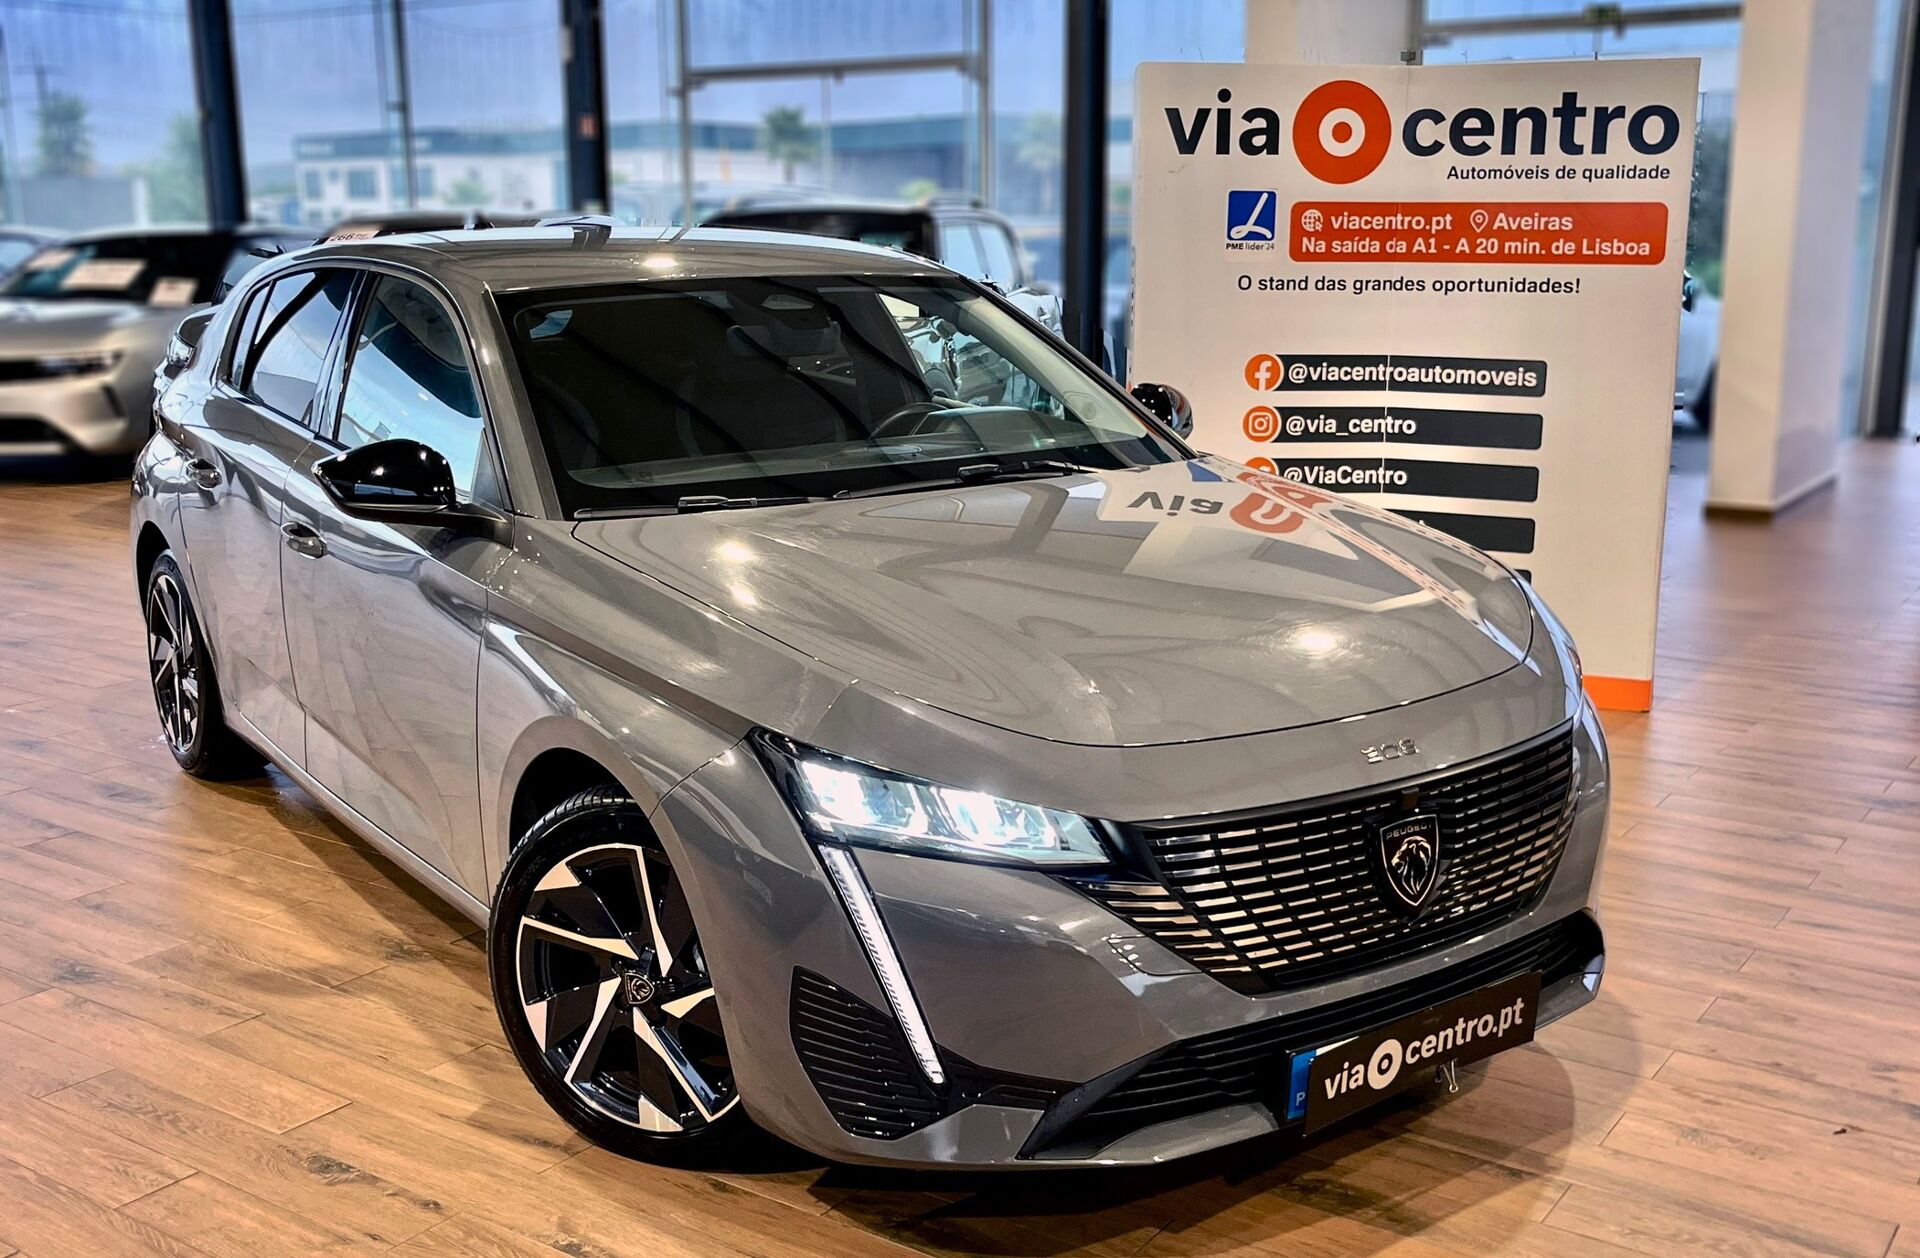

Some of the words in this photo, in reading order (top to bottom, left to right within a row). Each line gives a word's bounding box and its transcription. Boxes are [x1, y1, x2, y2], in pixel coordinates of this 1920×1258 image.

[1164, 87, 1280, 156] via
[1402, 91, 1680, 157] centro
[1446, 164, 1550, 180] Automóveis
[1555, 164, 1577, 180] de
[1582, 164, 1671, 183] qualidade
[1330, 212, 1453, 233] viacentro.pt
[1492, 212, 1573, 231] Aveiras
[1225, 242, 1244, 250] PME
[1301, 236, 1326, 253] Na
[1331, 236, 1380, 254] saída
[1385, 237, 1407, 254] da
[1411, 237, 1437, 254] A1
[1455, 237, 1470, 254] A
[1475, 237, 1499, 255] 20
[1504, 237, 1546, 255] min.
[1551, 238, 1576, 255] de
[1582, 238, 1650, 256] Lisboa
[1237, 274, 1252, 291] O
[1257, 275, 1309, 291] stand
[1314, 275, 1347, 291] das
[1352, 275, 1426, 295] grandes
[1431, 276, 1581, 296] oportunidades!
[1288, 362, 1538, 388] @viacentroautomoveis
[1285, 413, 1417, 436] @via_centro
[1283, 465, 1407, 486] @ViaCentro
[1324, 1061, 1365, 1100] via
[1405, 997, 1525, 1064] centro.pt
[1295, 1091, 1306, 1107] P
